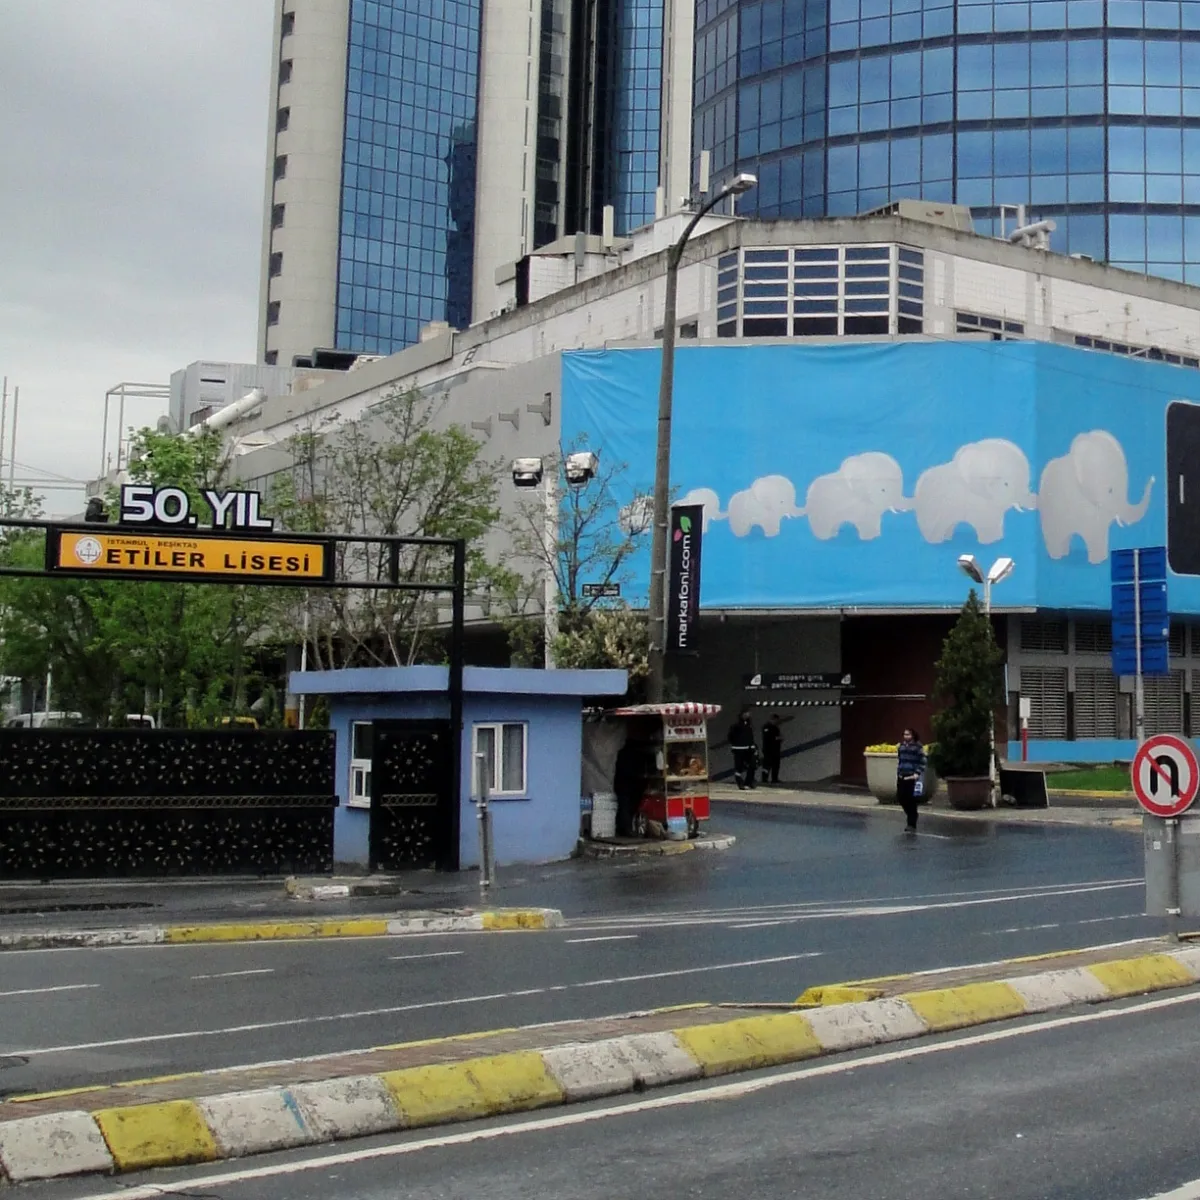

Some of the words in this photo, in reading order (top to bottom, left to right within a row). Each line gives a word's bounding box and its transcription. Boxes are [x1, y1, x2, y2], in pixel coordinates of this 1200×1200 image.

[122, 486, 197, 525] 50.
[206, 491, 272, 528] YIL
[106, 546, 205, 568] ETİLER
[224, 551, 310, 572] LİSESİ
[107, 538, 148, 546] İSTANBUL
[677, 534, 691, 648] markafoni.com
